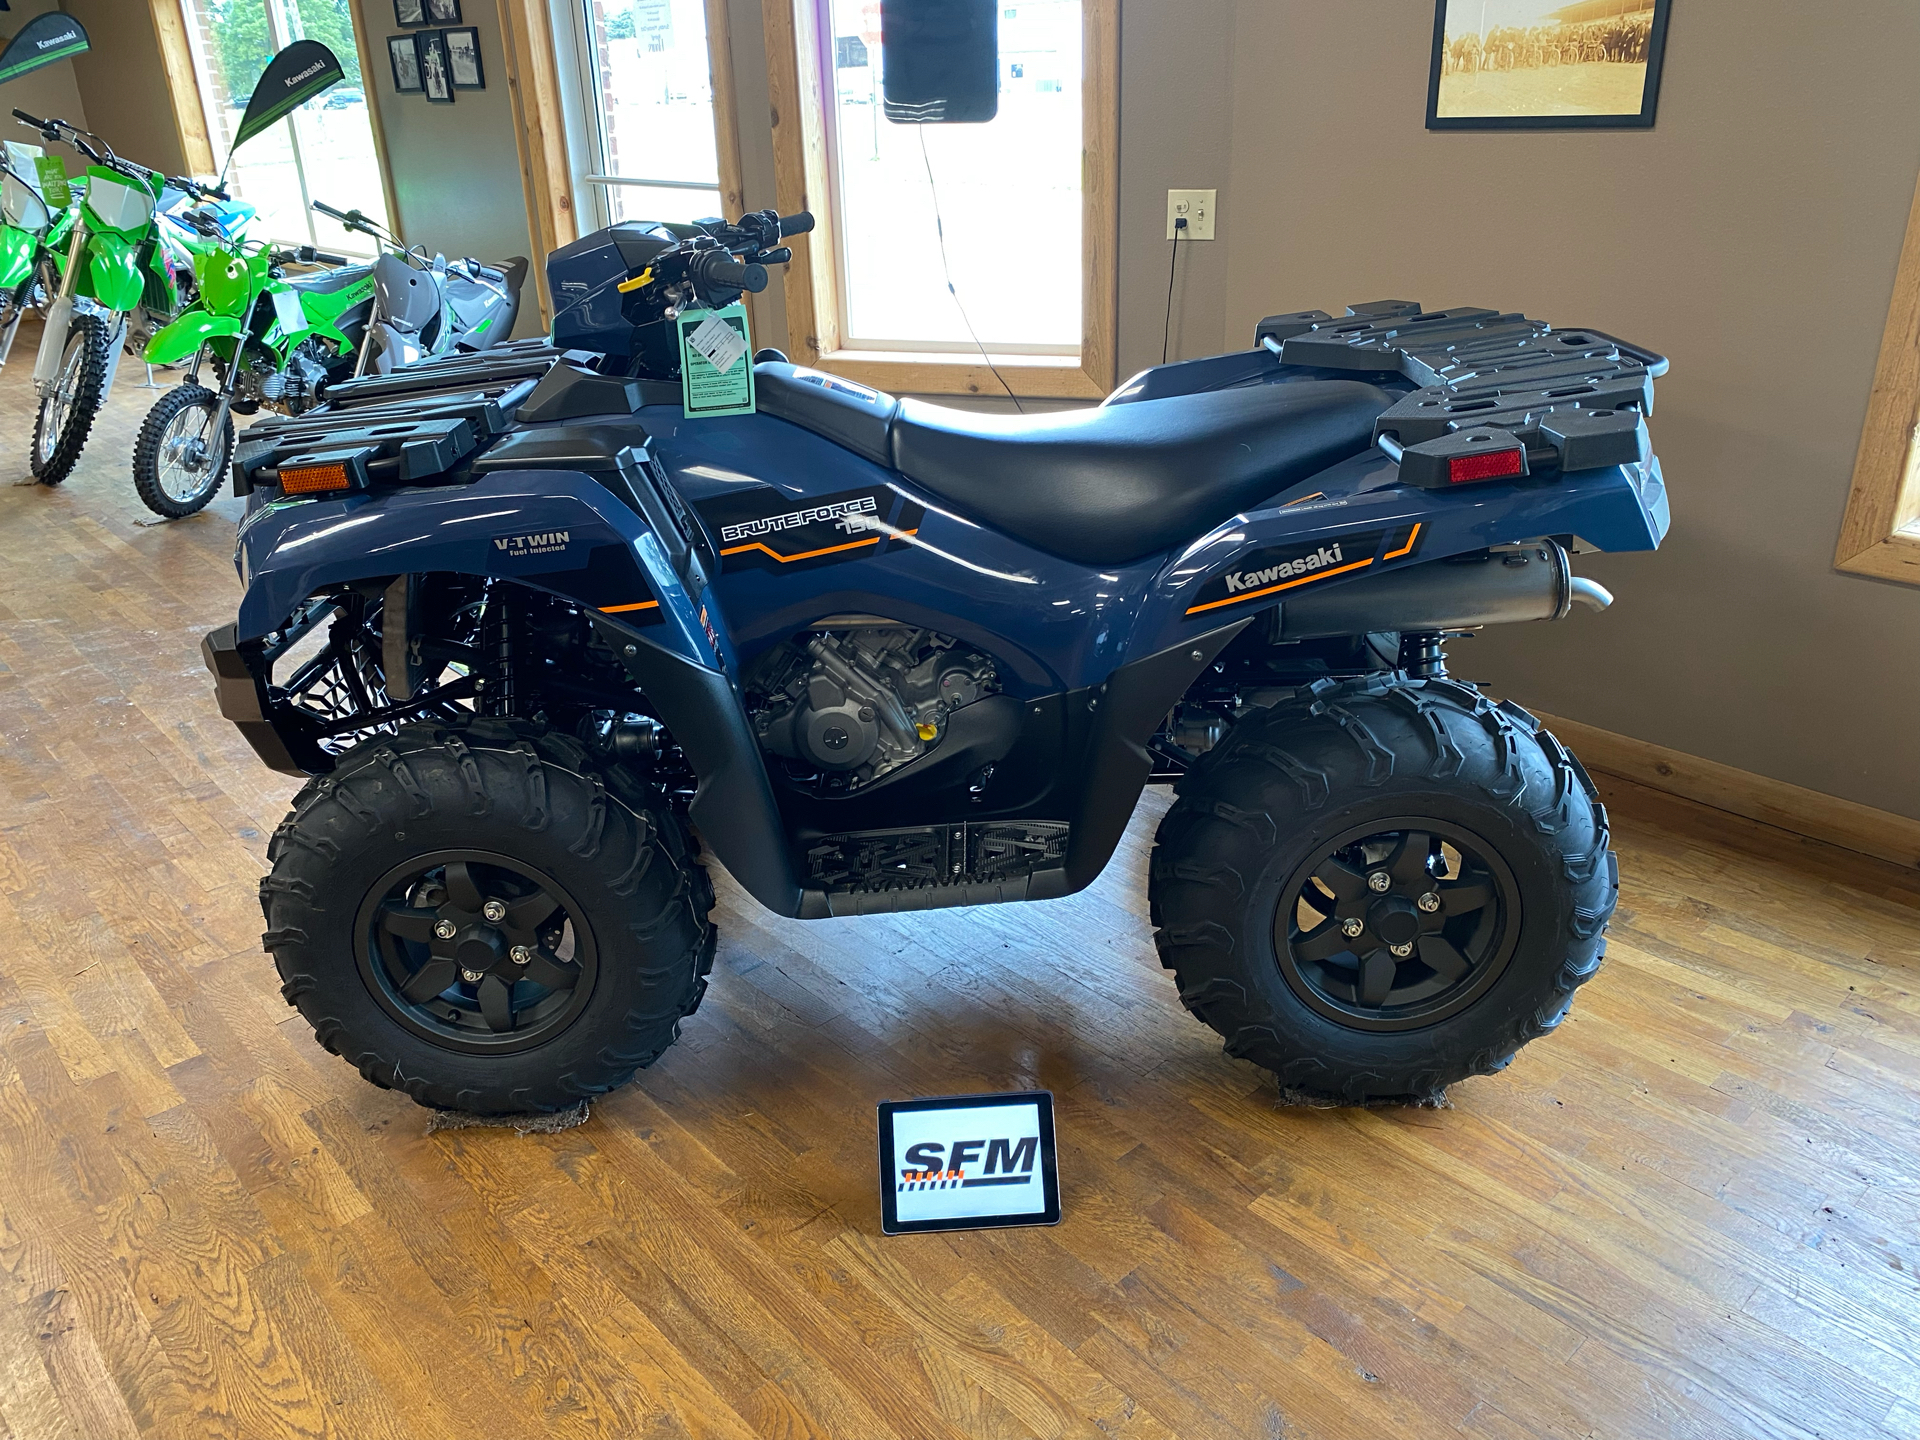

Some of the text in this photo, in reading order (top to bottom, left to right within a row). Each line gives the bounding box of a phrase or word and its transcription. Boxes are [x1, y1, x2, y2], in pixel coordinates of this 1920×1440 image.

[36, 30, 77, 49] Kawasaki
[284, 59, 326, 87] Kawasaki
[346, 280, 373, 301] Kawasaki
[721, 496, 877, 542] BRUTE FORCE
[834, 514, 881, 535] 750
[493, 531, 570, 550] V-TWIN
[509, 544, 566, 556] Fuel Injected
[1225, 543, 1343, 593] Kawasaki
[901, 1137, 1038, 1180] SFM
